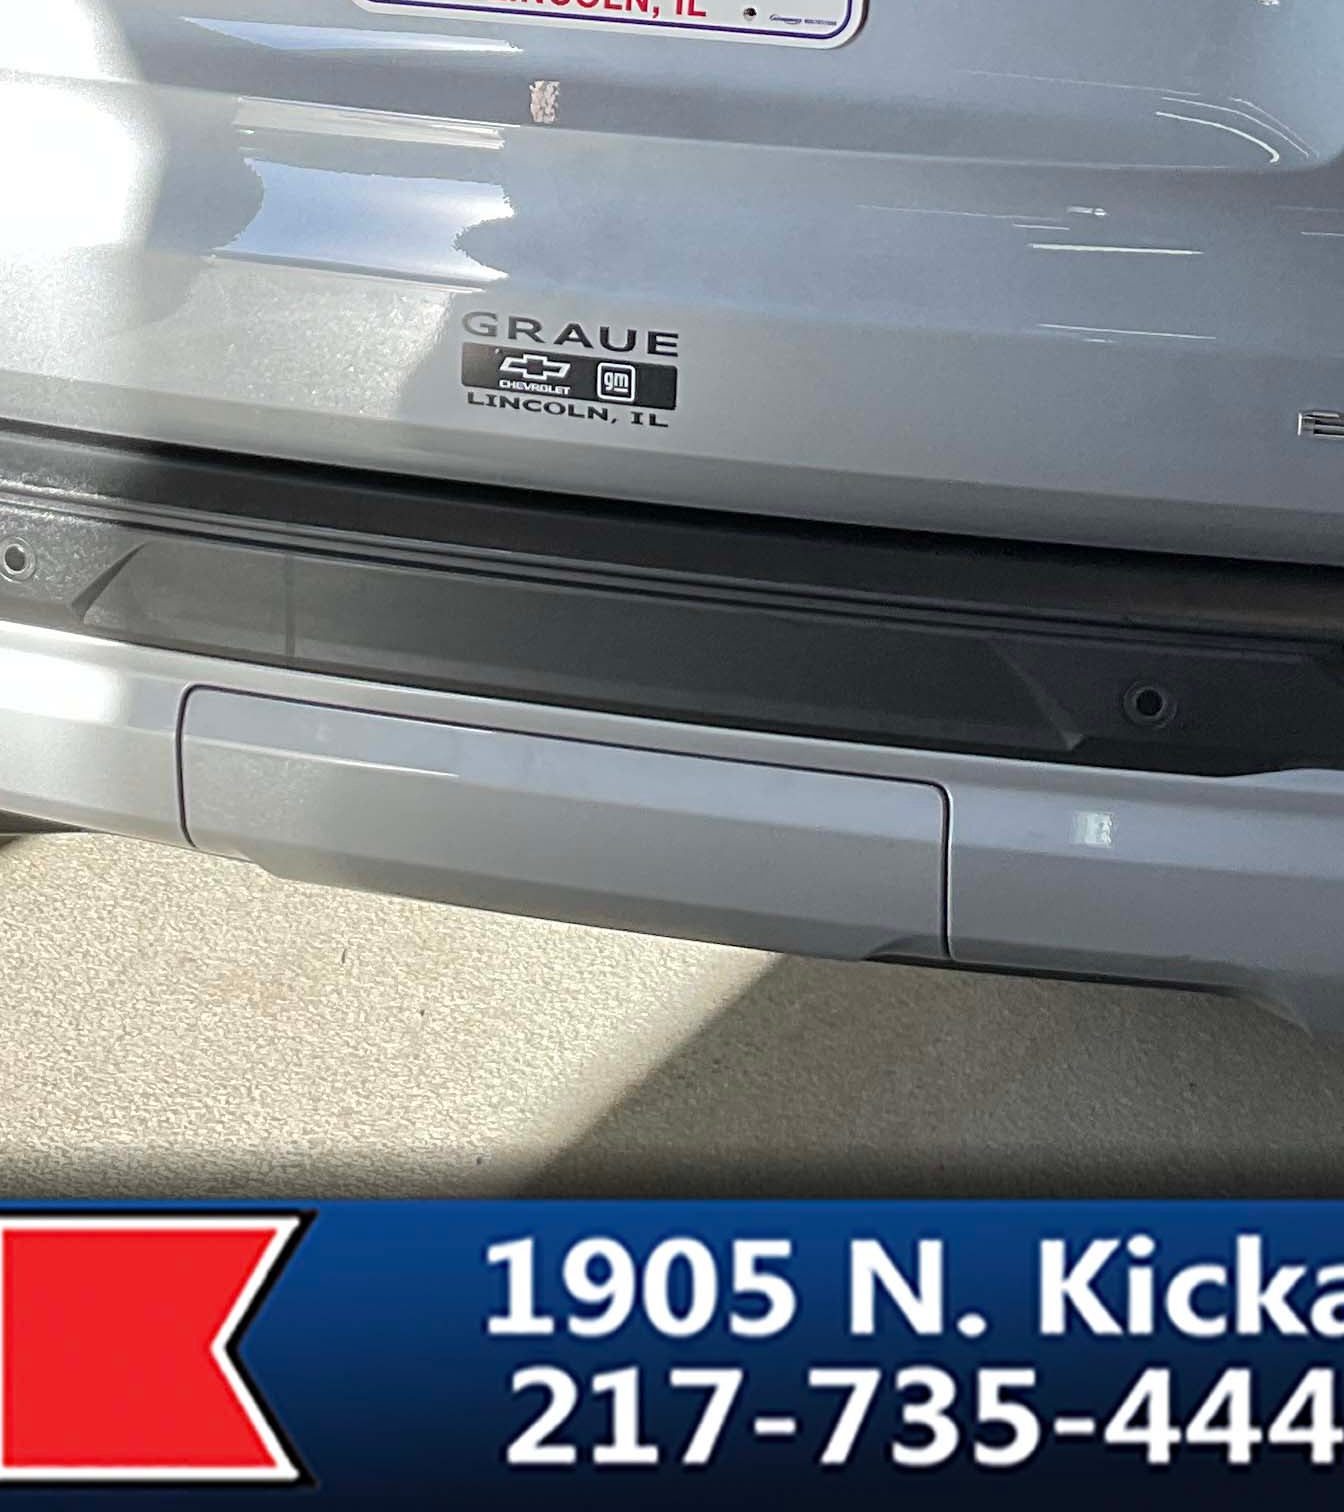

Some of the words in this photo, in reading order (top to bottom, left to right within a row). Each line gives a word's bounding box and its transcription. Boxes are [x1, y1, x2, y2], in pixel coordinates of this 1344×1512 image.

[461, 311, 680, 357] GRAUE
[498, 379, 571, 395] CHEVROLET
[604, 372, 630, 393] gm
[467, 391, 618, 424] LINCOLN,
[630, 411, 669, 428] IL
